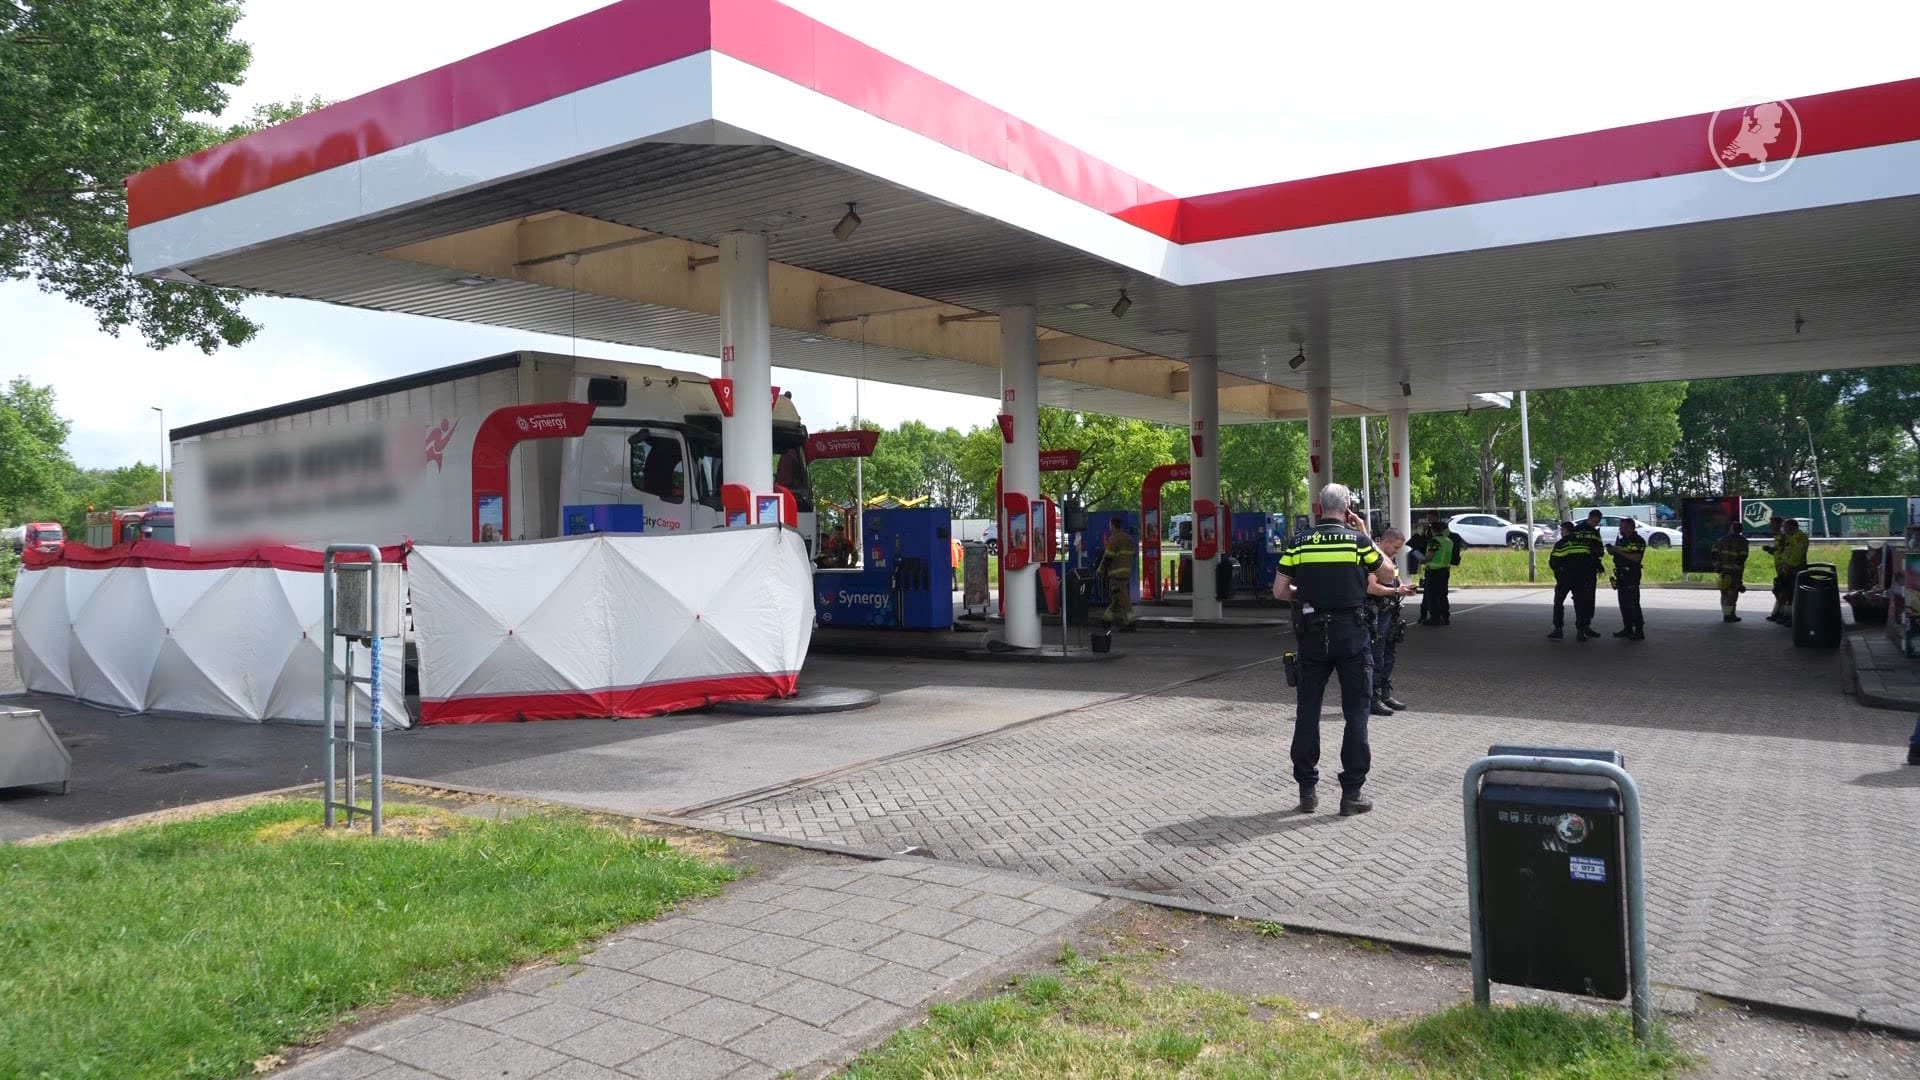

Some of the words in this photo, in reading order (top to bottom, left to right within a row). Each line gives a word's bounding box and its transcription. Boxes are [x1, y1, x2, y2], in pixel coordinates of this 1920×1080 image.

[723, 386, 730, 398] 9
[529, 417, 567, 430] Synergy
[828, 441, 860, 451] Synergy
[839, 590, 889, 609] Synergy
